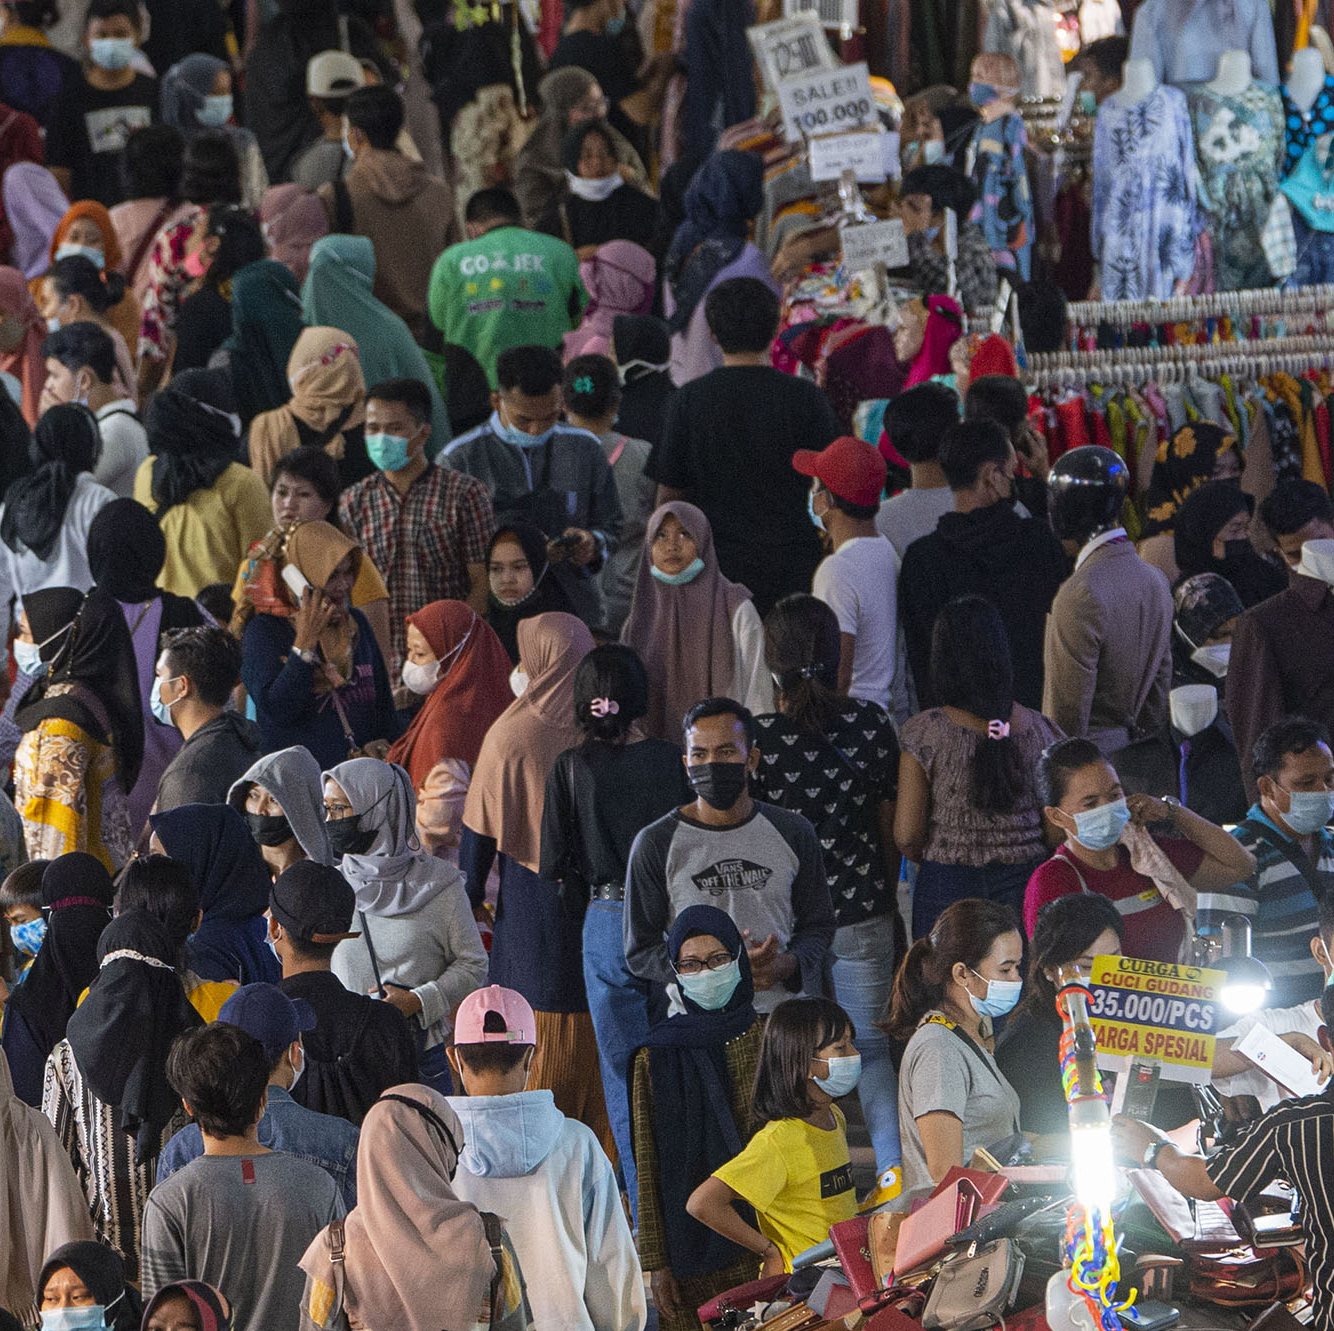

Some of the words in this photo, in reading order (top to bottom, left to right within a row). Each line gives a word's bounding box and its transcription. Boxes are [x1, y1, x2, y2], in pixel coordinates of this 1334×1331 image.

[792, 76, 858, 106] SALE!!
[714, 860, 744, 875] VANS
[721, 873, 741, 887] THE
[1118, 958, 1180, 978] CURGA
[1101, 972, 1140, 989] CUCI
[1146, 978, 1214, 999] GUDANG
[1090, 989, 1214, 1030] 35.000/PCS
[1144, 1032, 1208, 1062] SPESIAL
